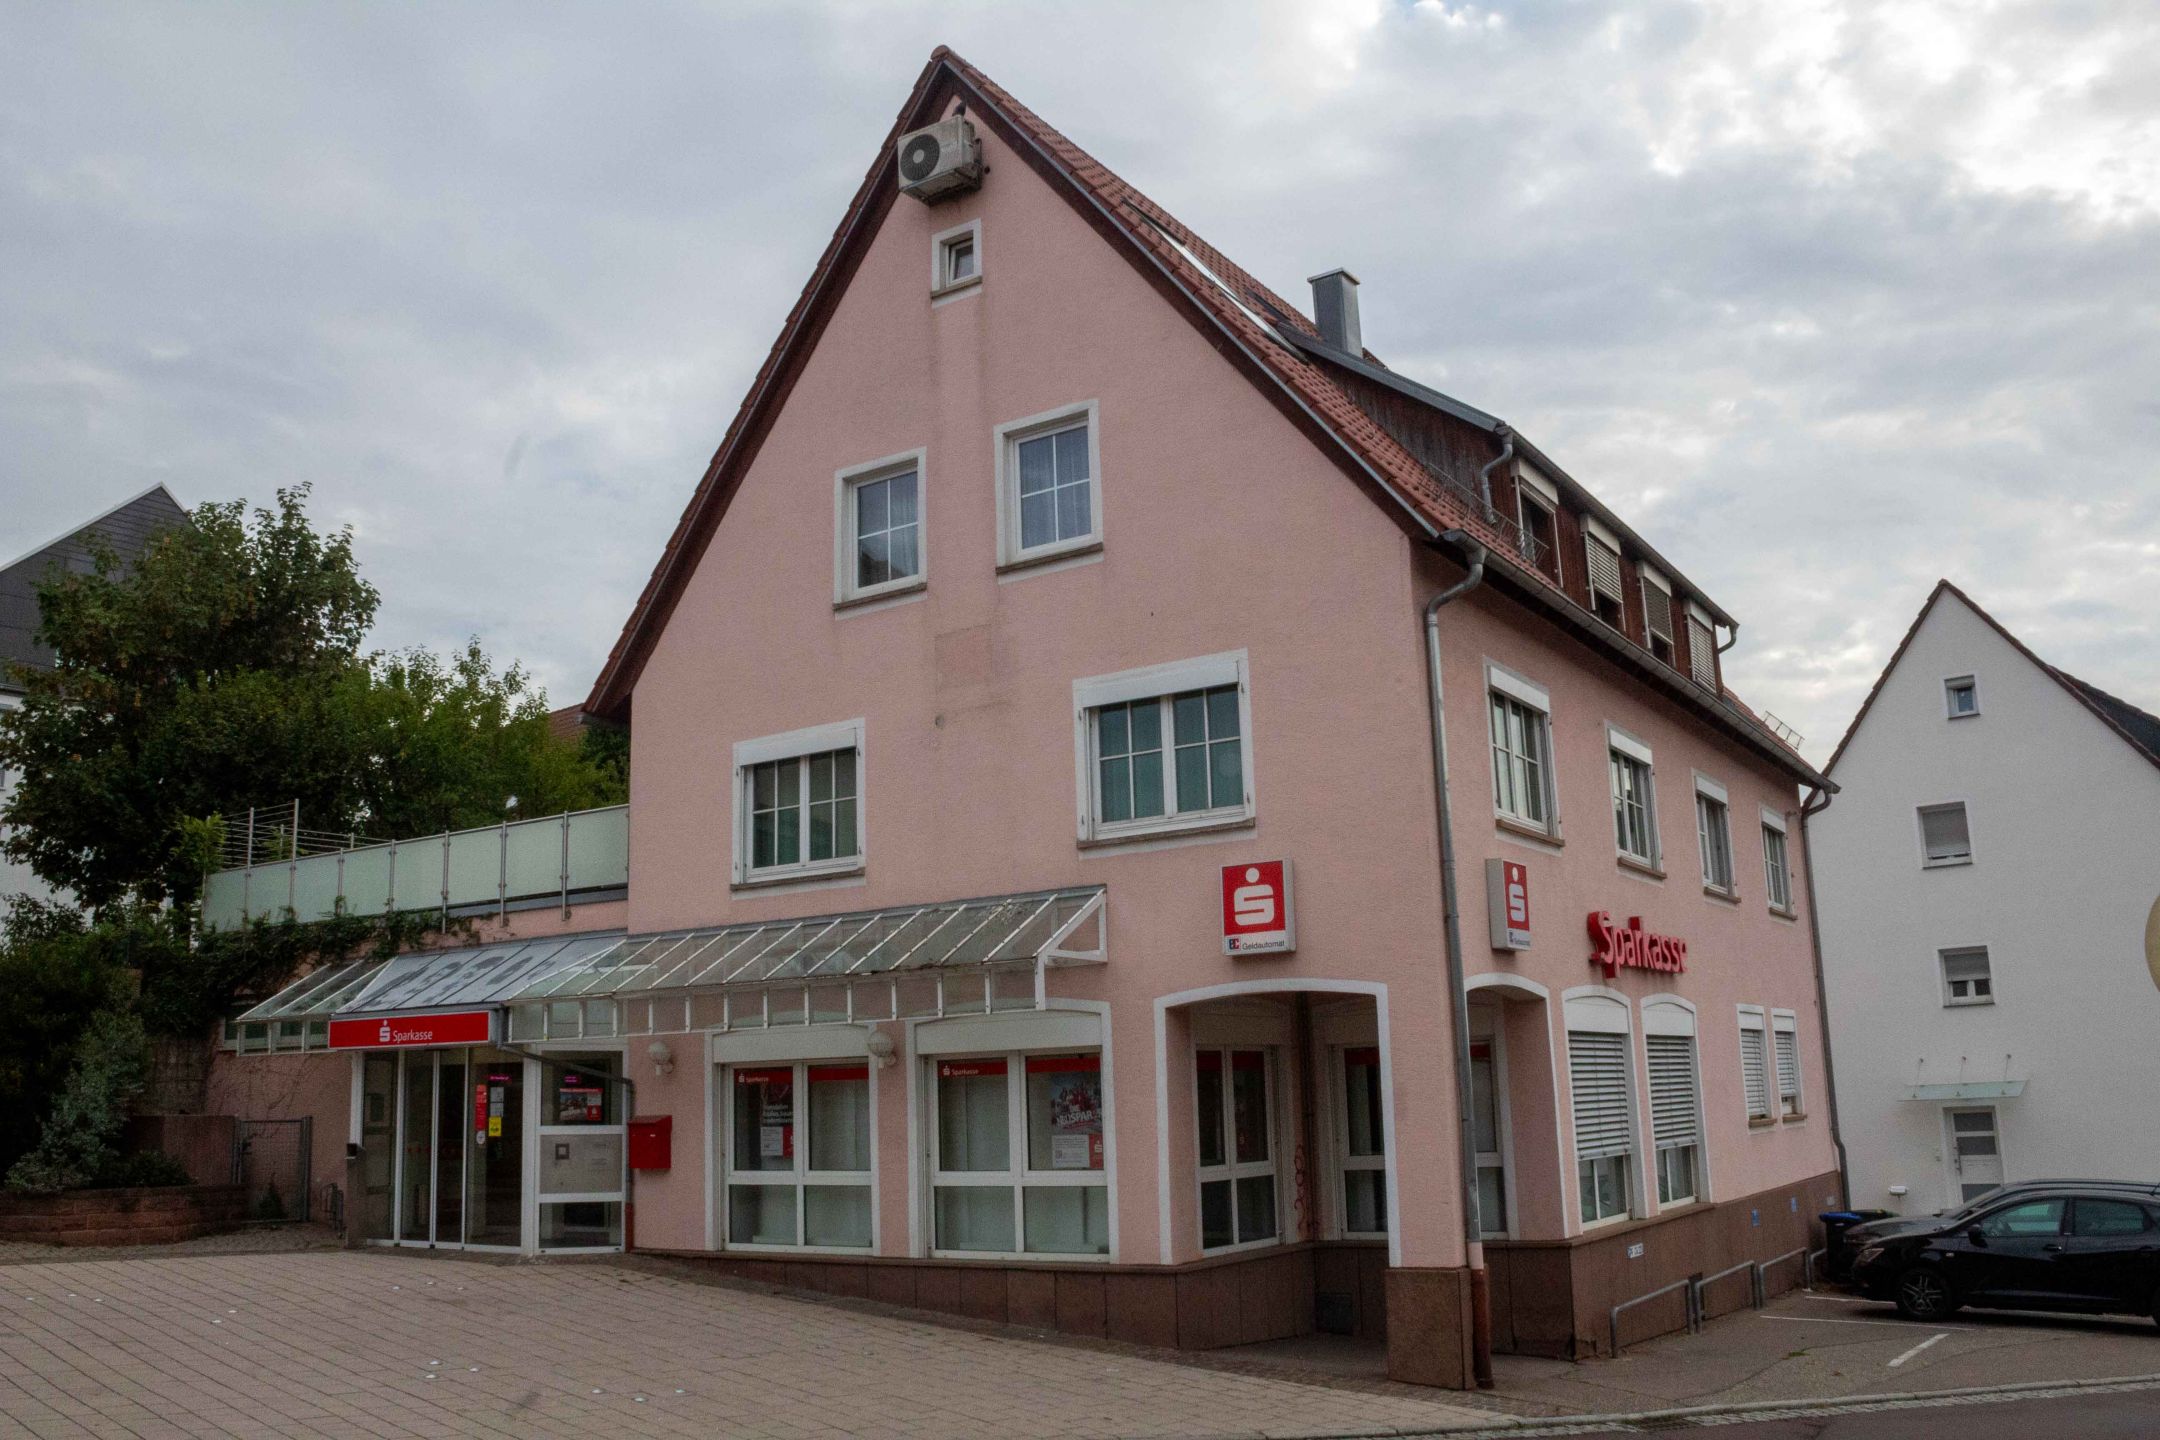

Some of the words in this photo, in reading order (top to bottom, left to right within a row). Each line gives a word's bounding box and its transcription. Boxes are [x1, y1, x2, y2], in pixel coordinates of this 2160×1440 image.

[1242, 940, 1285, 950] Geldautomat
[1589, 911, 1687, 978] Sparkasse
[392, 1029, 433, 1044] Sparkasse
[951, 1068, 979, 1076] Sparkasse
